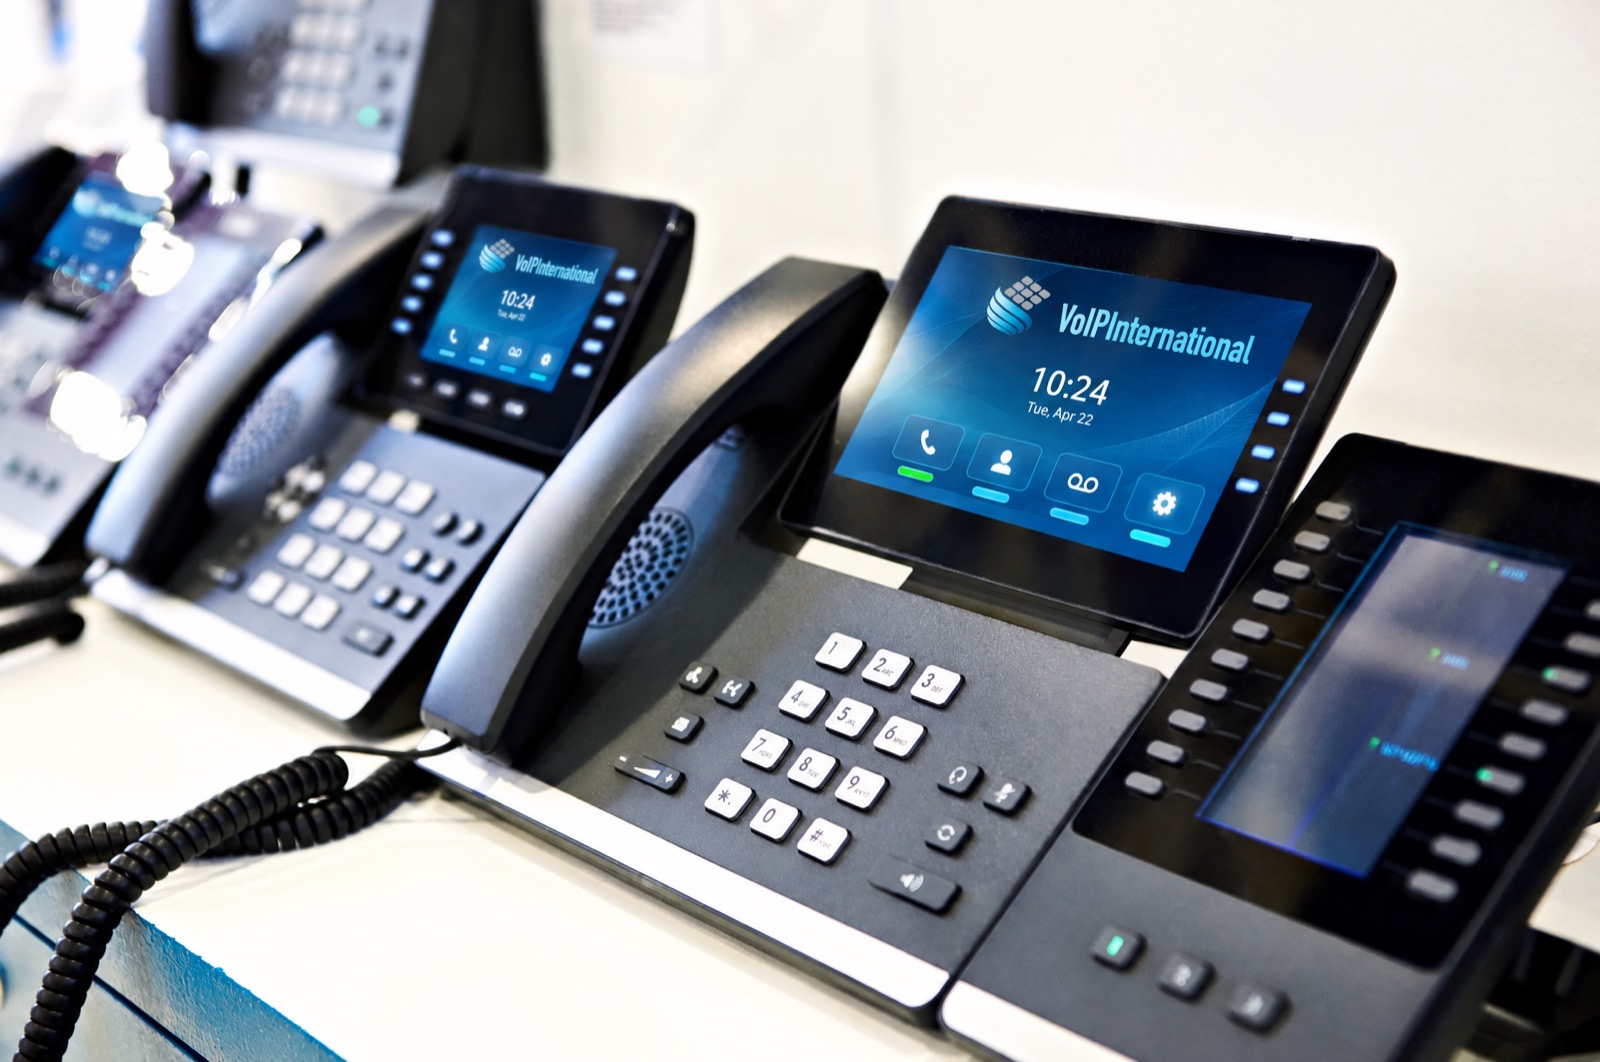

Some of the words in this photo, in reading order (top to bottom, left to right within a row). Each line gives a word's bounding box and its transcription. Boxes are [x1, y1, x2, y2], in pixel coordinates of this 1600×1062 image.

[515, 254, 599, 285] VoIPInternational
[501, 289, 536, 311] 10:24
[1058, 303, 1256, 365] VoIPInternational
[1033, 366, 1111, 406] 10:24
[1028, 400, 1051, 418] Tue,
[1053, 406, 1077, 424] Apr
[1076, 413, 1094, 426] 22
[828, 641, 838, 655] 1
[873, 657, 887, 673] 2
[921, 673, 935, 688] 3
[930, 684, 944, 693] DEF
[791, 690, 804, 703] 4
[836, 706, 852, 721] 5
[884, 725, 898, 740] 6
[752, 737, 766, 751] 7
[799, 756, 813, 771] 8
[808, 768, 820, 778] TUV
[846, 775, 860, 790] 9
[762, 808, 776, 823] 0
